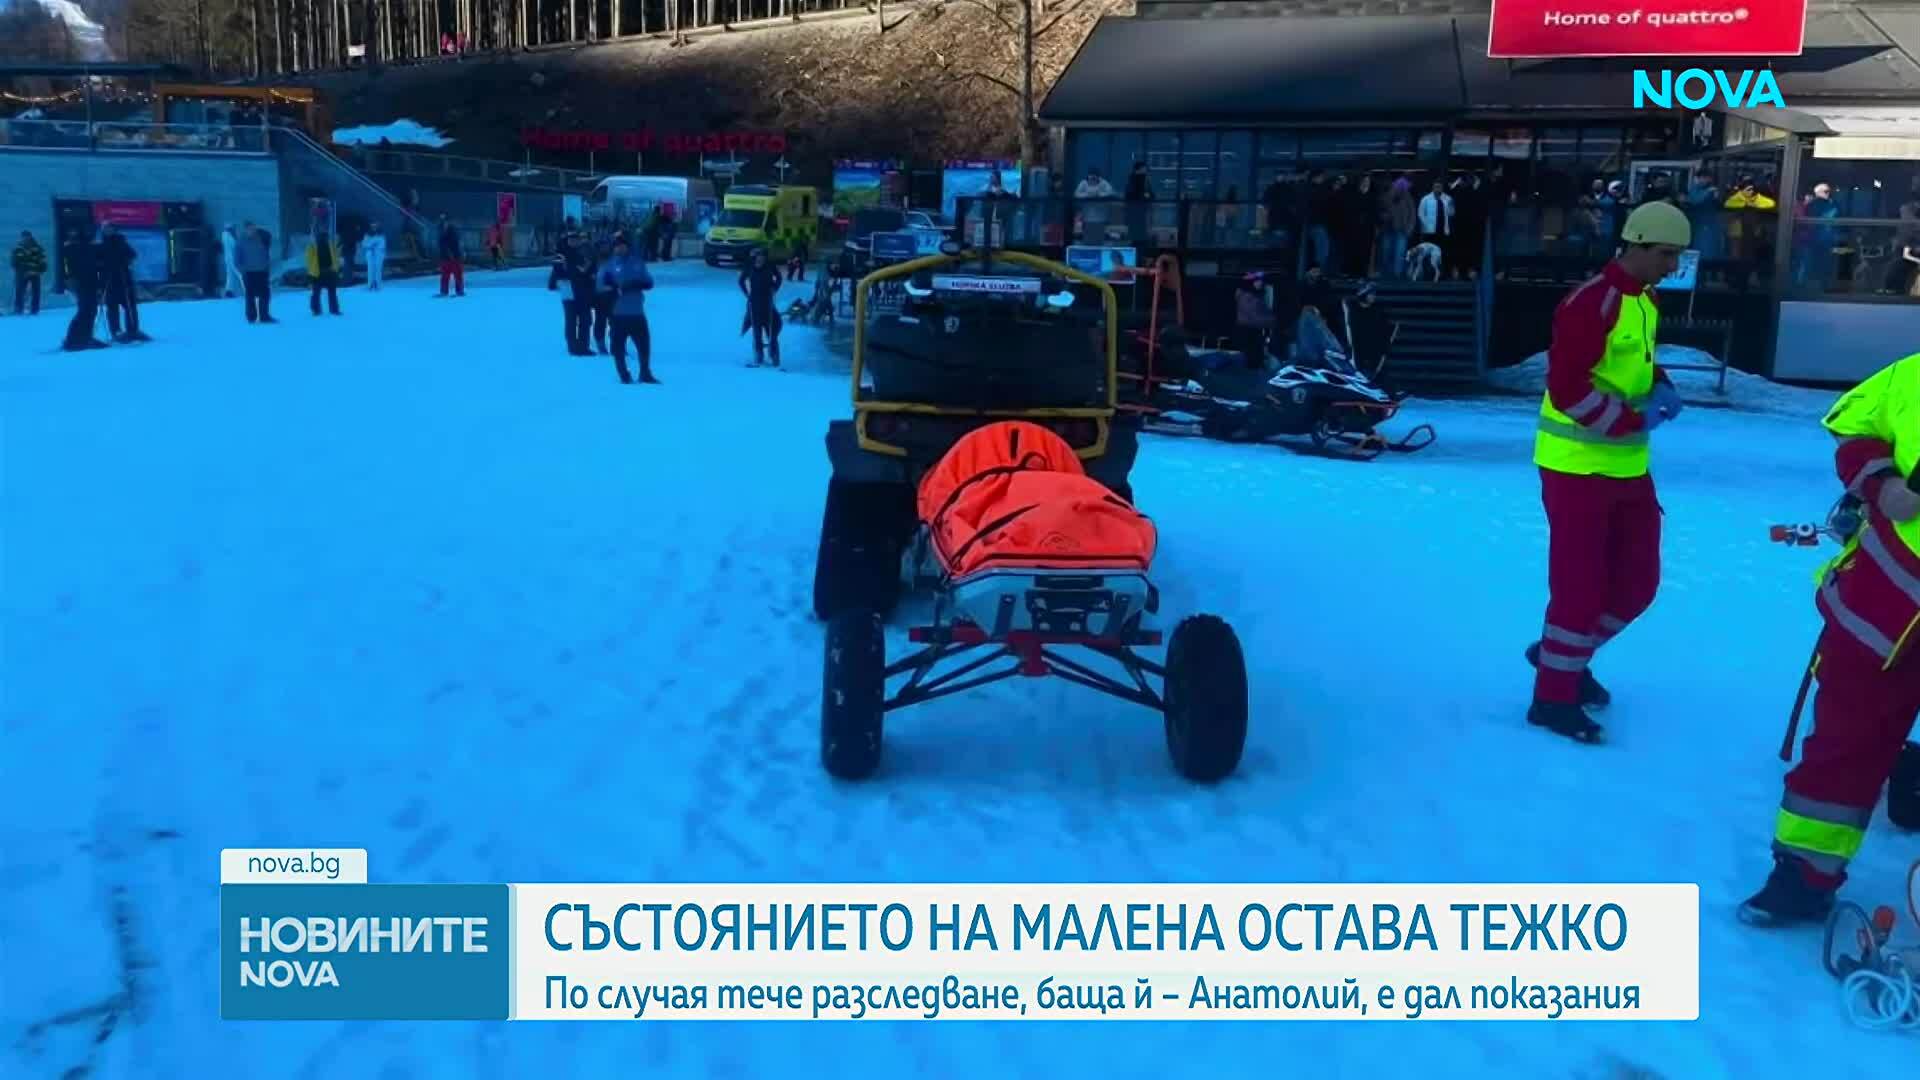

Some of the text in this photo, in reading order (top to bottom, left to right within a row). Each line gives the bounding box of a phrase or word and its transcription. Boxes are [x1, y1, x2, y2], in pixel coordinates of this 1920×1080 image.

[1544, 11, 1611, 26] Home
[1616, 9, 1642, 25] of
[520, 126, 786, 156] Home of quattro
